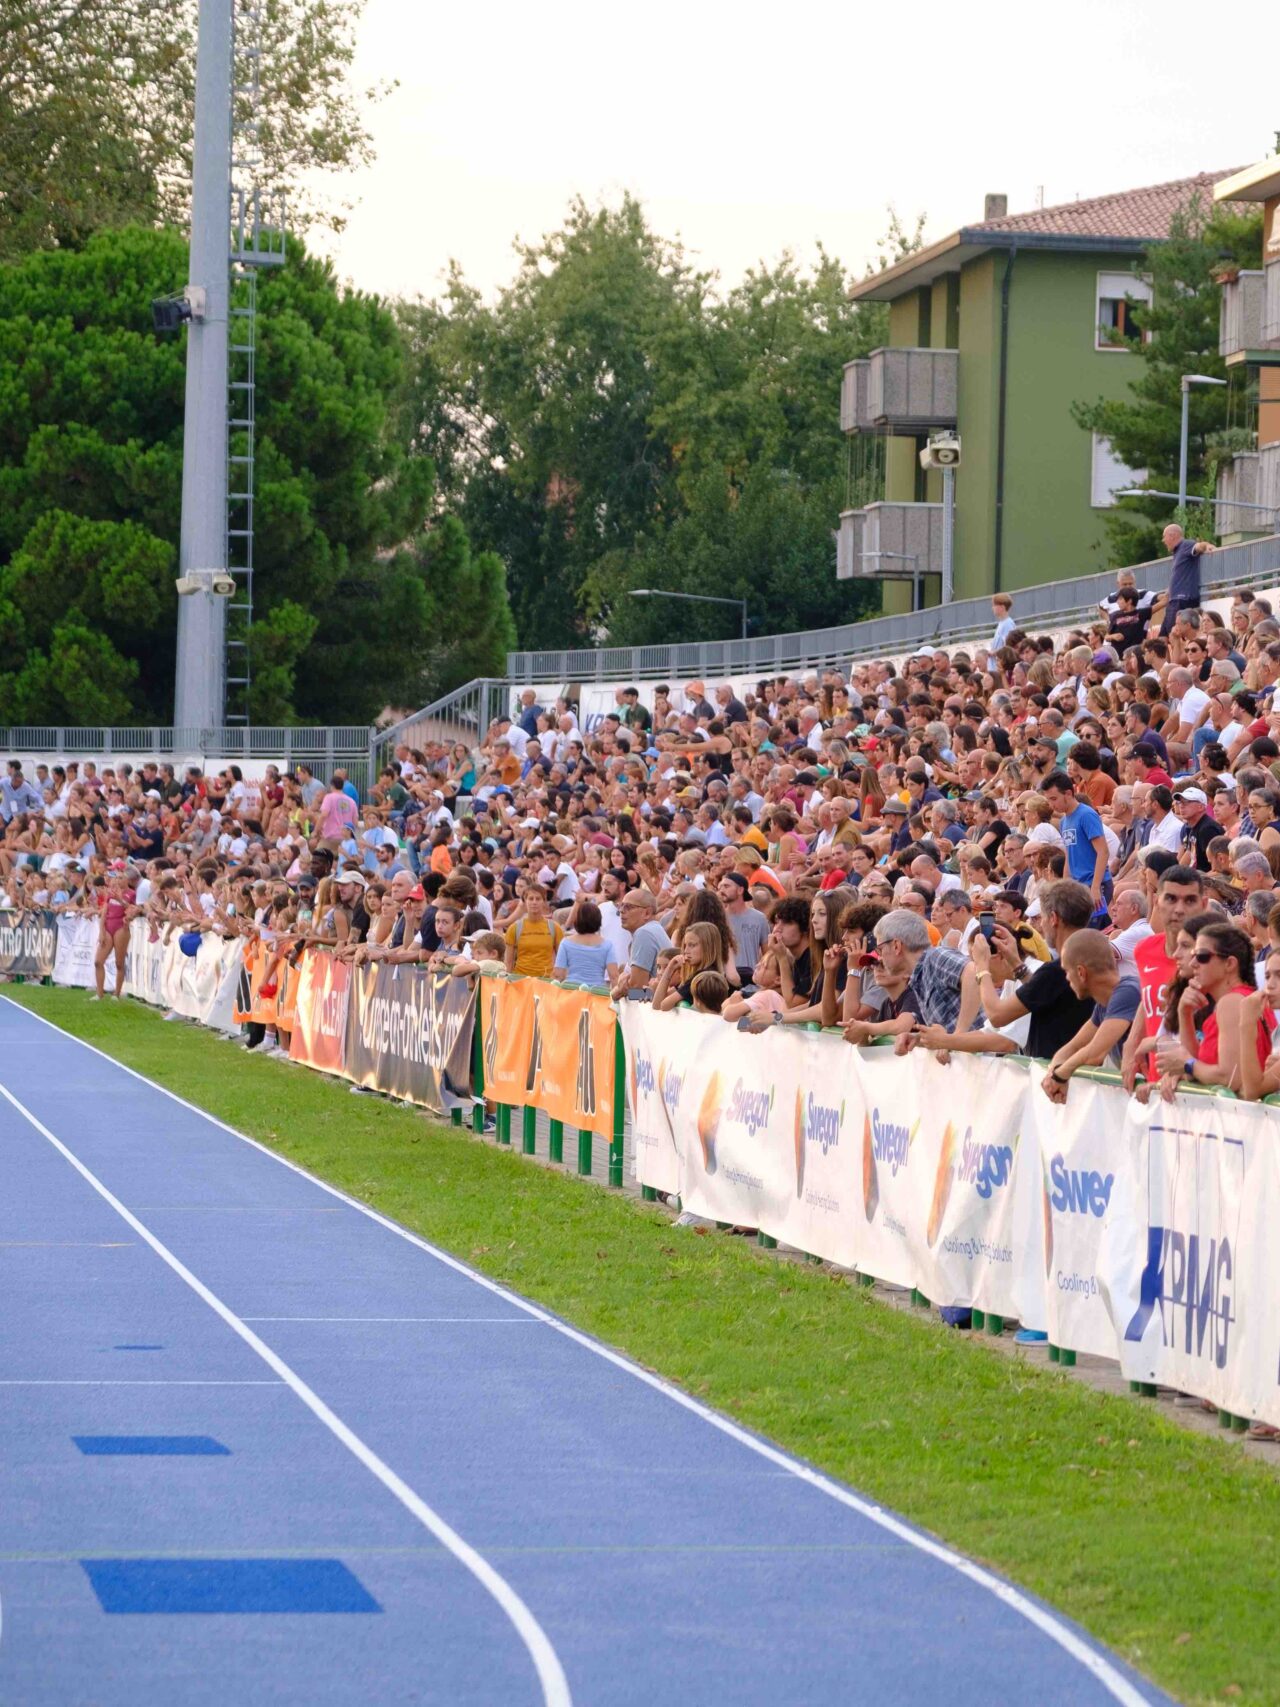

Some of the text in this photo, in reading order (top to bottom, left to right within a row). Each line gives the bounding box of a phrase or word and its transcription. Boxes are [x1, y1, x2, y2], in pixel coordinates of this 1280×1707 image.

[1142, 985, 1168, 1018] US
[726, 1077, 770, 1137] Swegon
[807, 1091, 839, 1156] Swegon
[873, 1107, 910, 1177] Swegon
[1057, 1271, 1090, 1299] Cooling
[1124, 1227, 1233, 1369] KPMG
